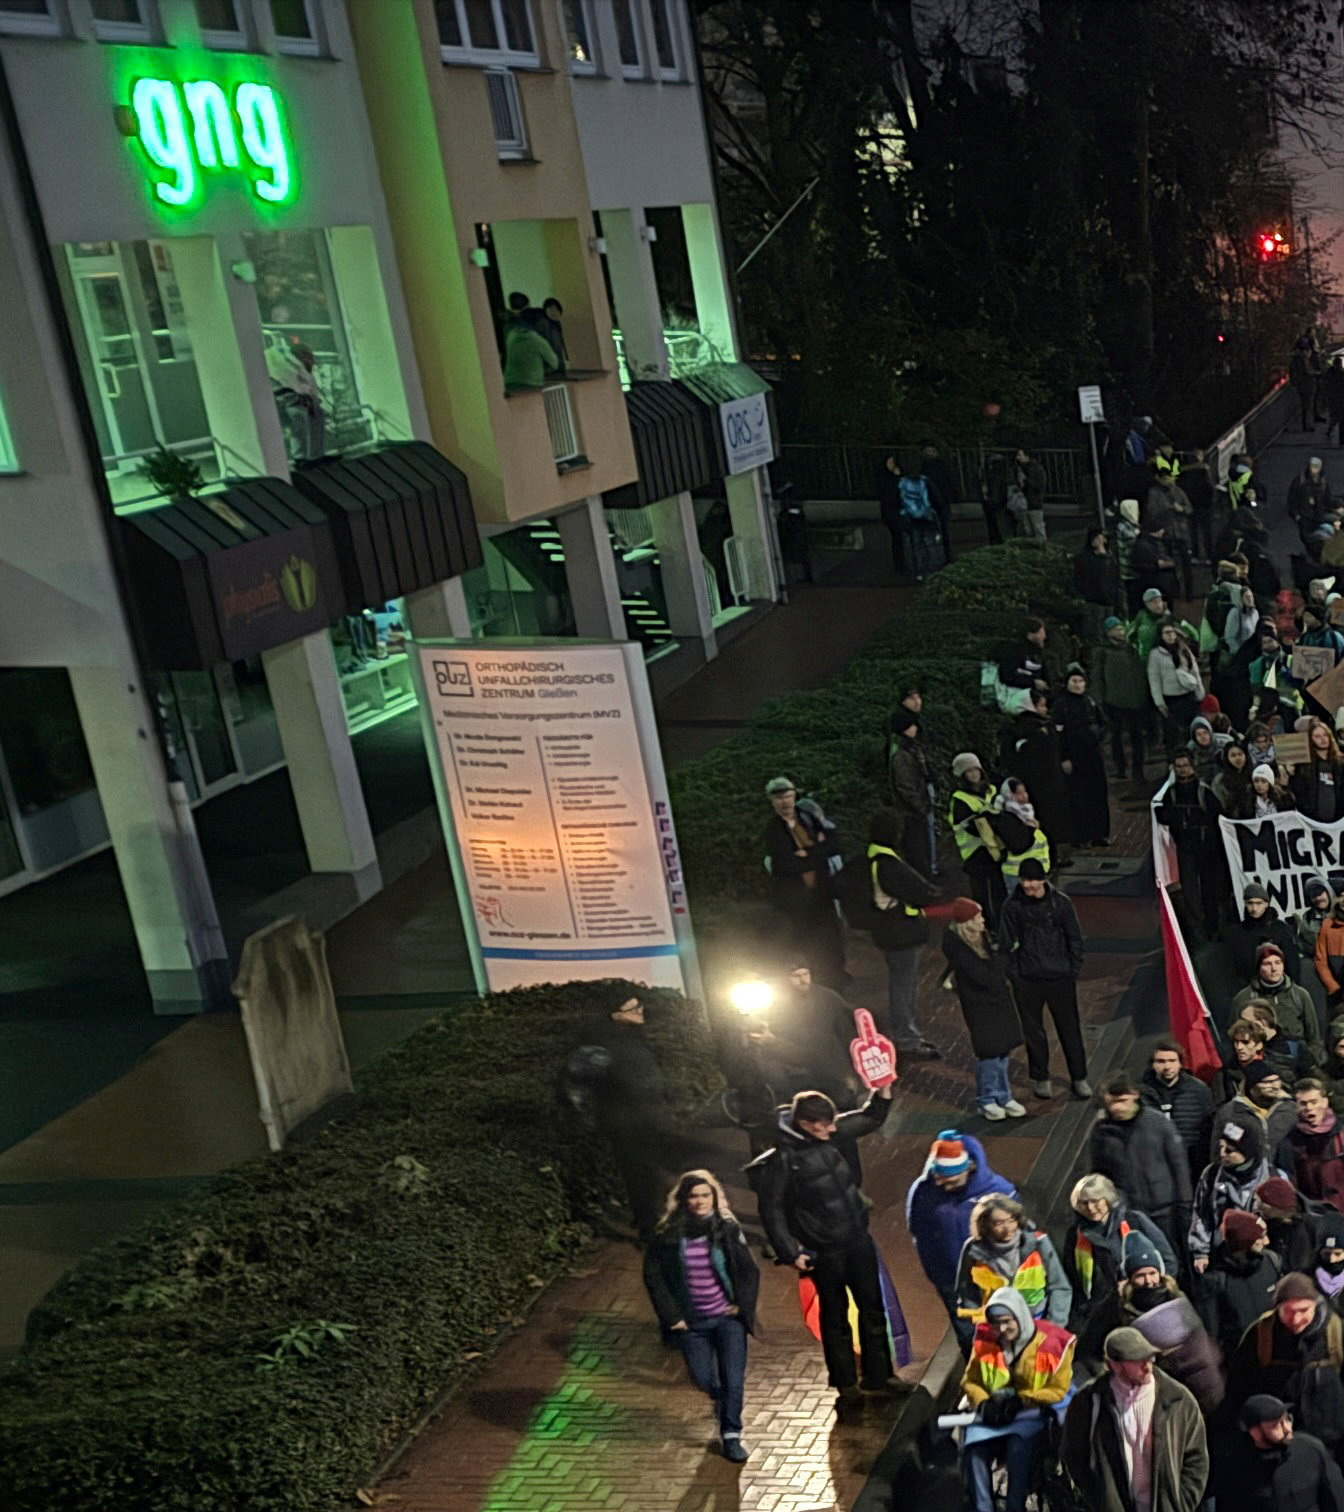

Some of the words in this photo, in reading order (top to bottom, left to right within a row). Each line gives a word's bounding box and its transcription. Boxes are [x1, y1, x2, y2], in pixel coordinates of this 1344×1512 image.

[133, 78, 288, 204] gng
[475, 661, 564, 673] ORTHOPÄDISCH
[478, 673, 615, 685] UNFALLCHIRURGISCHES
[481, 688, 535, 699] ZENTRUM
